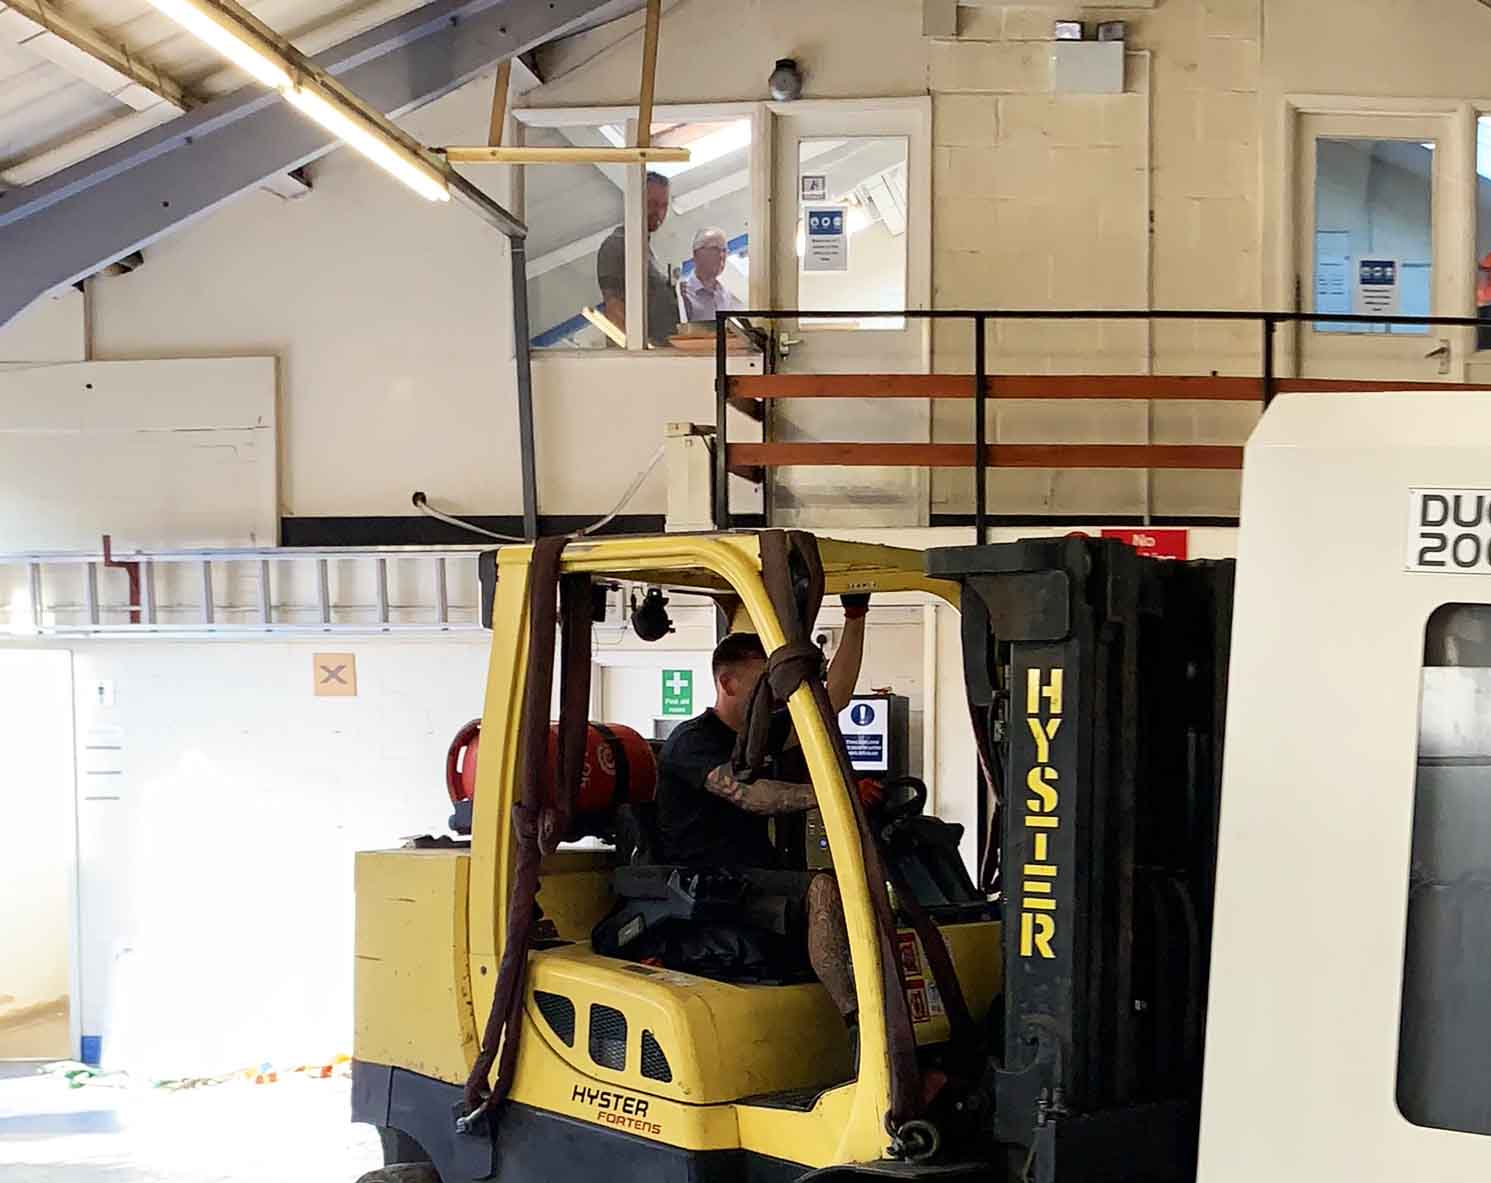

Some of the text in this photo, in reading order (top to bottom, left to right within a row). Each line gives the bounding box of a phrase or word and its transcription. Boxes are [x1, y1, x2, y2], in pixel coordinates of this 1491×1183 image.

[1132, 534, 1156, 547] No
[1020, 668, 1064, 959] HYSTER
[572, 1084, 649, 1118] HYSTER
[597, 1111, 662, 1135] FORTENS
